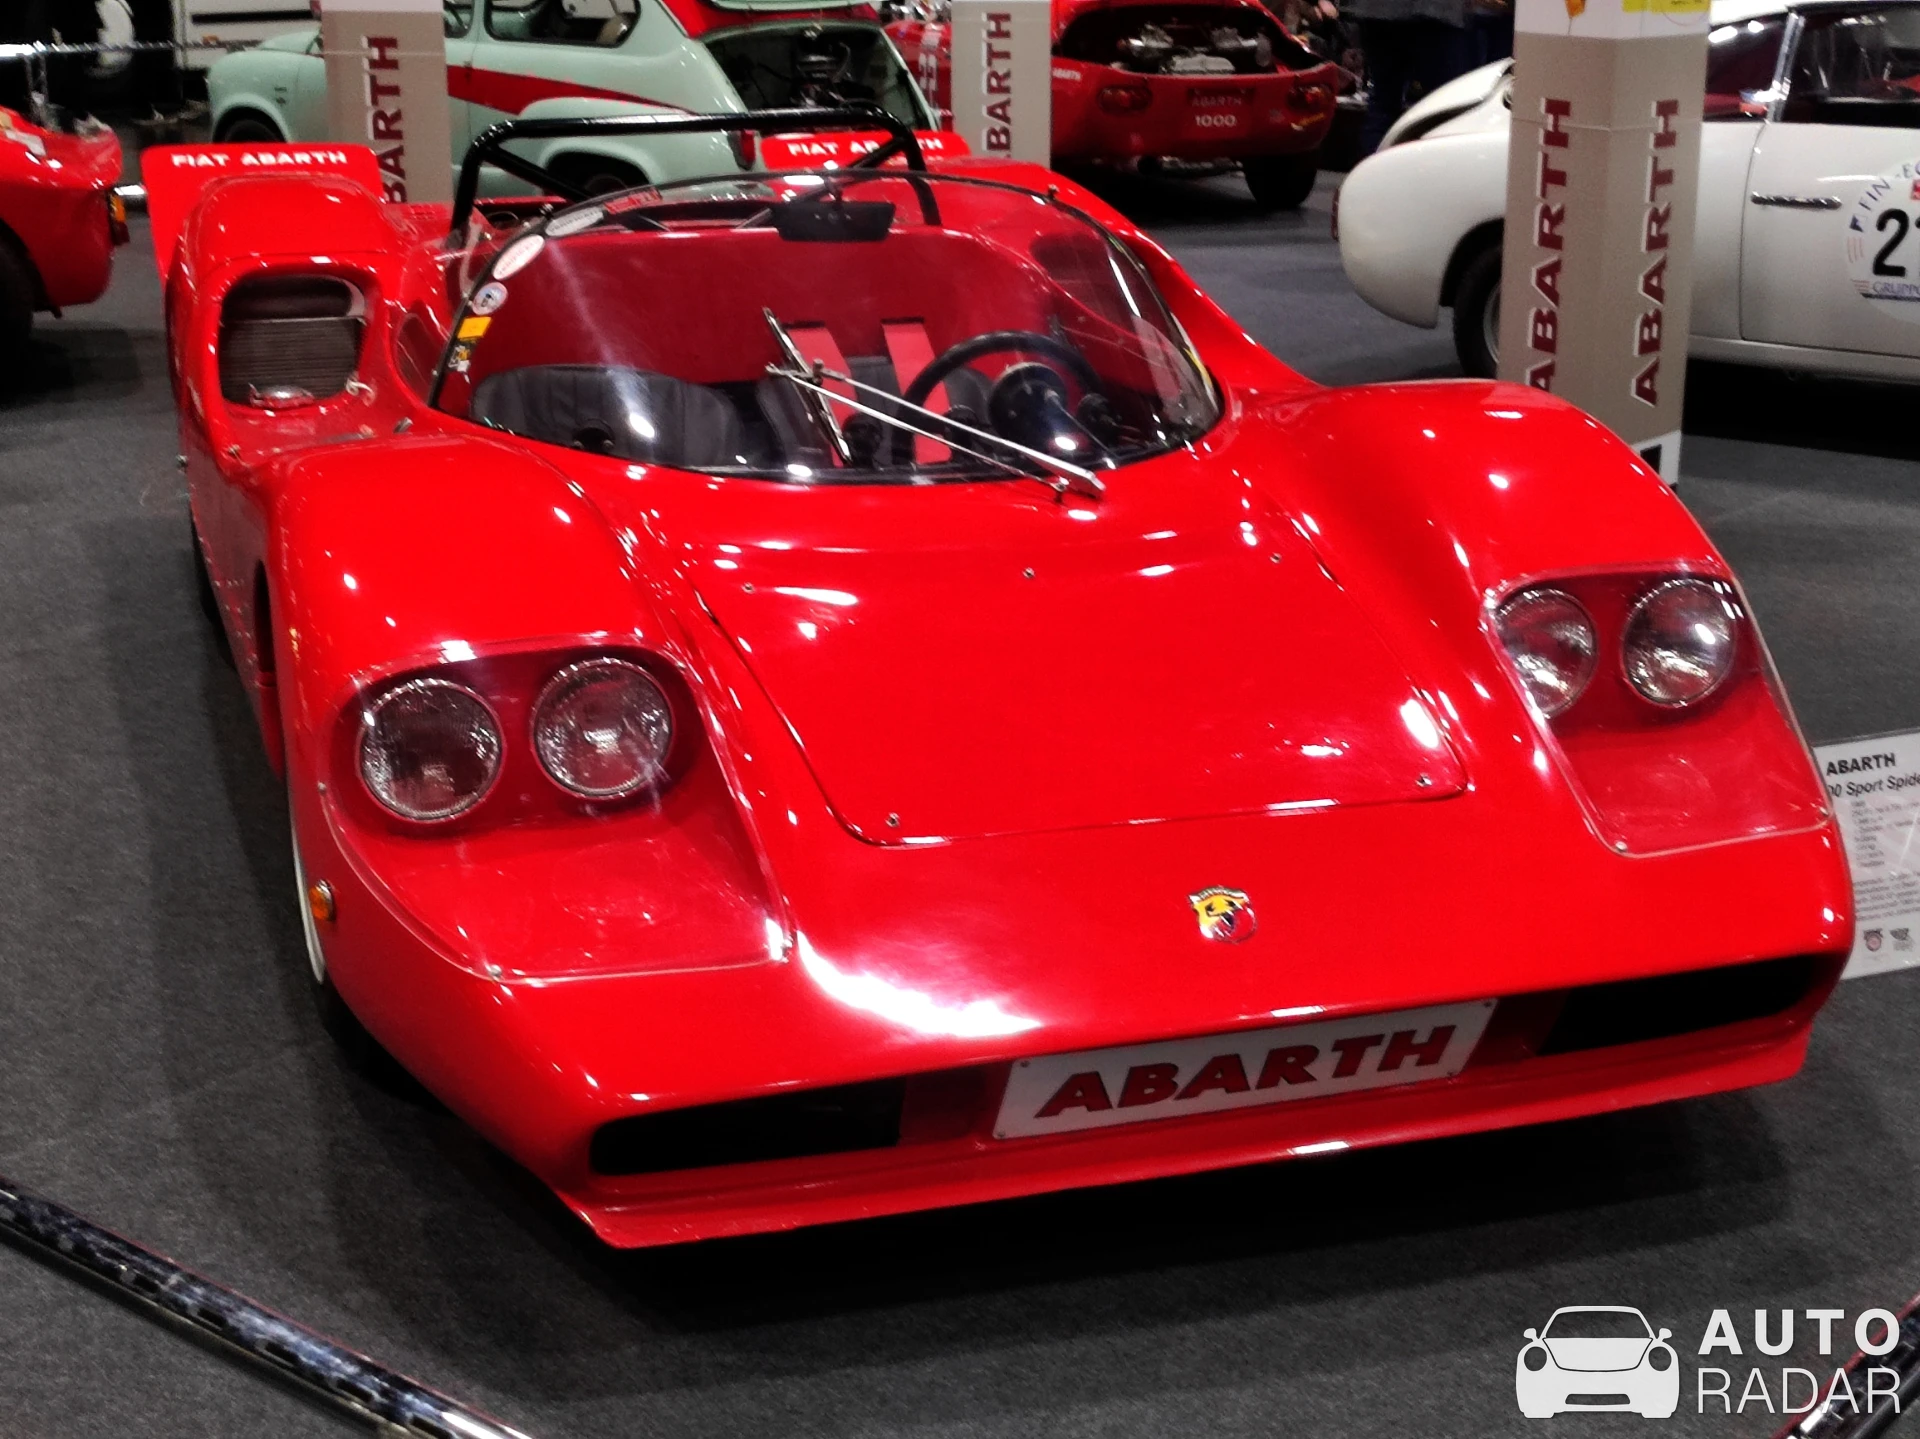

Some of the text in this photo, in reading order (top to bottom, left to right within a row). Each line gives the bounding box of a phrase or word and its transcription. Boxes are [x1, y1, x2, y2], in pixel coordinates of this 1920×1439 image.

[984, 13, 1012, 157] BARTH
[363, 36, 408, 204] BARTH
[786, 141, 839, 156] FIAT
[1194, 114, 1237, 127] 1000
[171, 151, 348, 167] FIAT ABARTH
[1526, 97, 1571, 392] ABARTH
[1632, 99, 1679, 407] ABARTH
[1826, 752, 1896, 776] ABARTH
[1846, 780, 1883, 798] Sport
[1033, 1024, 1457, 1119] ABARTH
